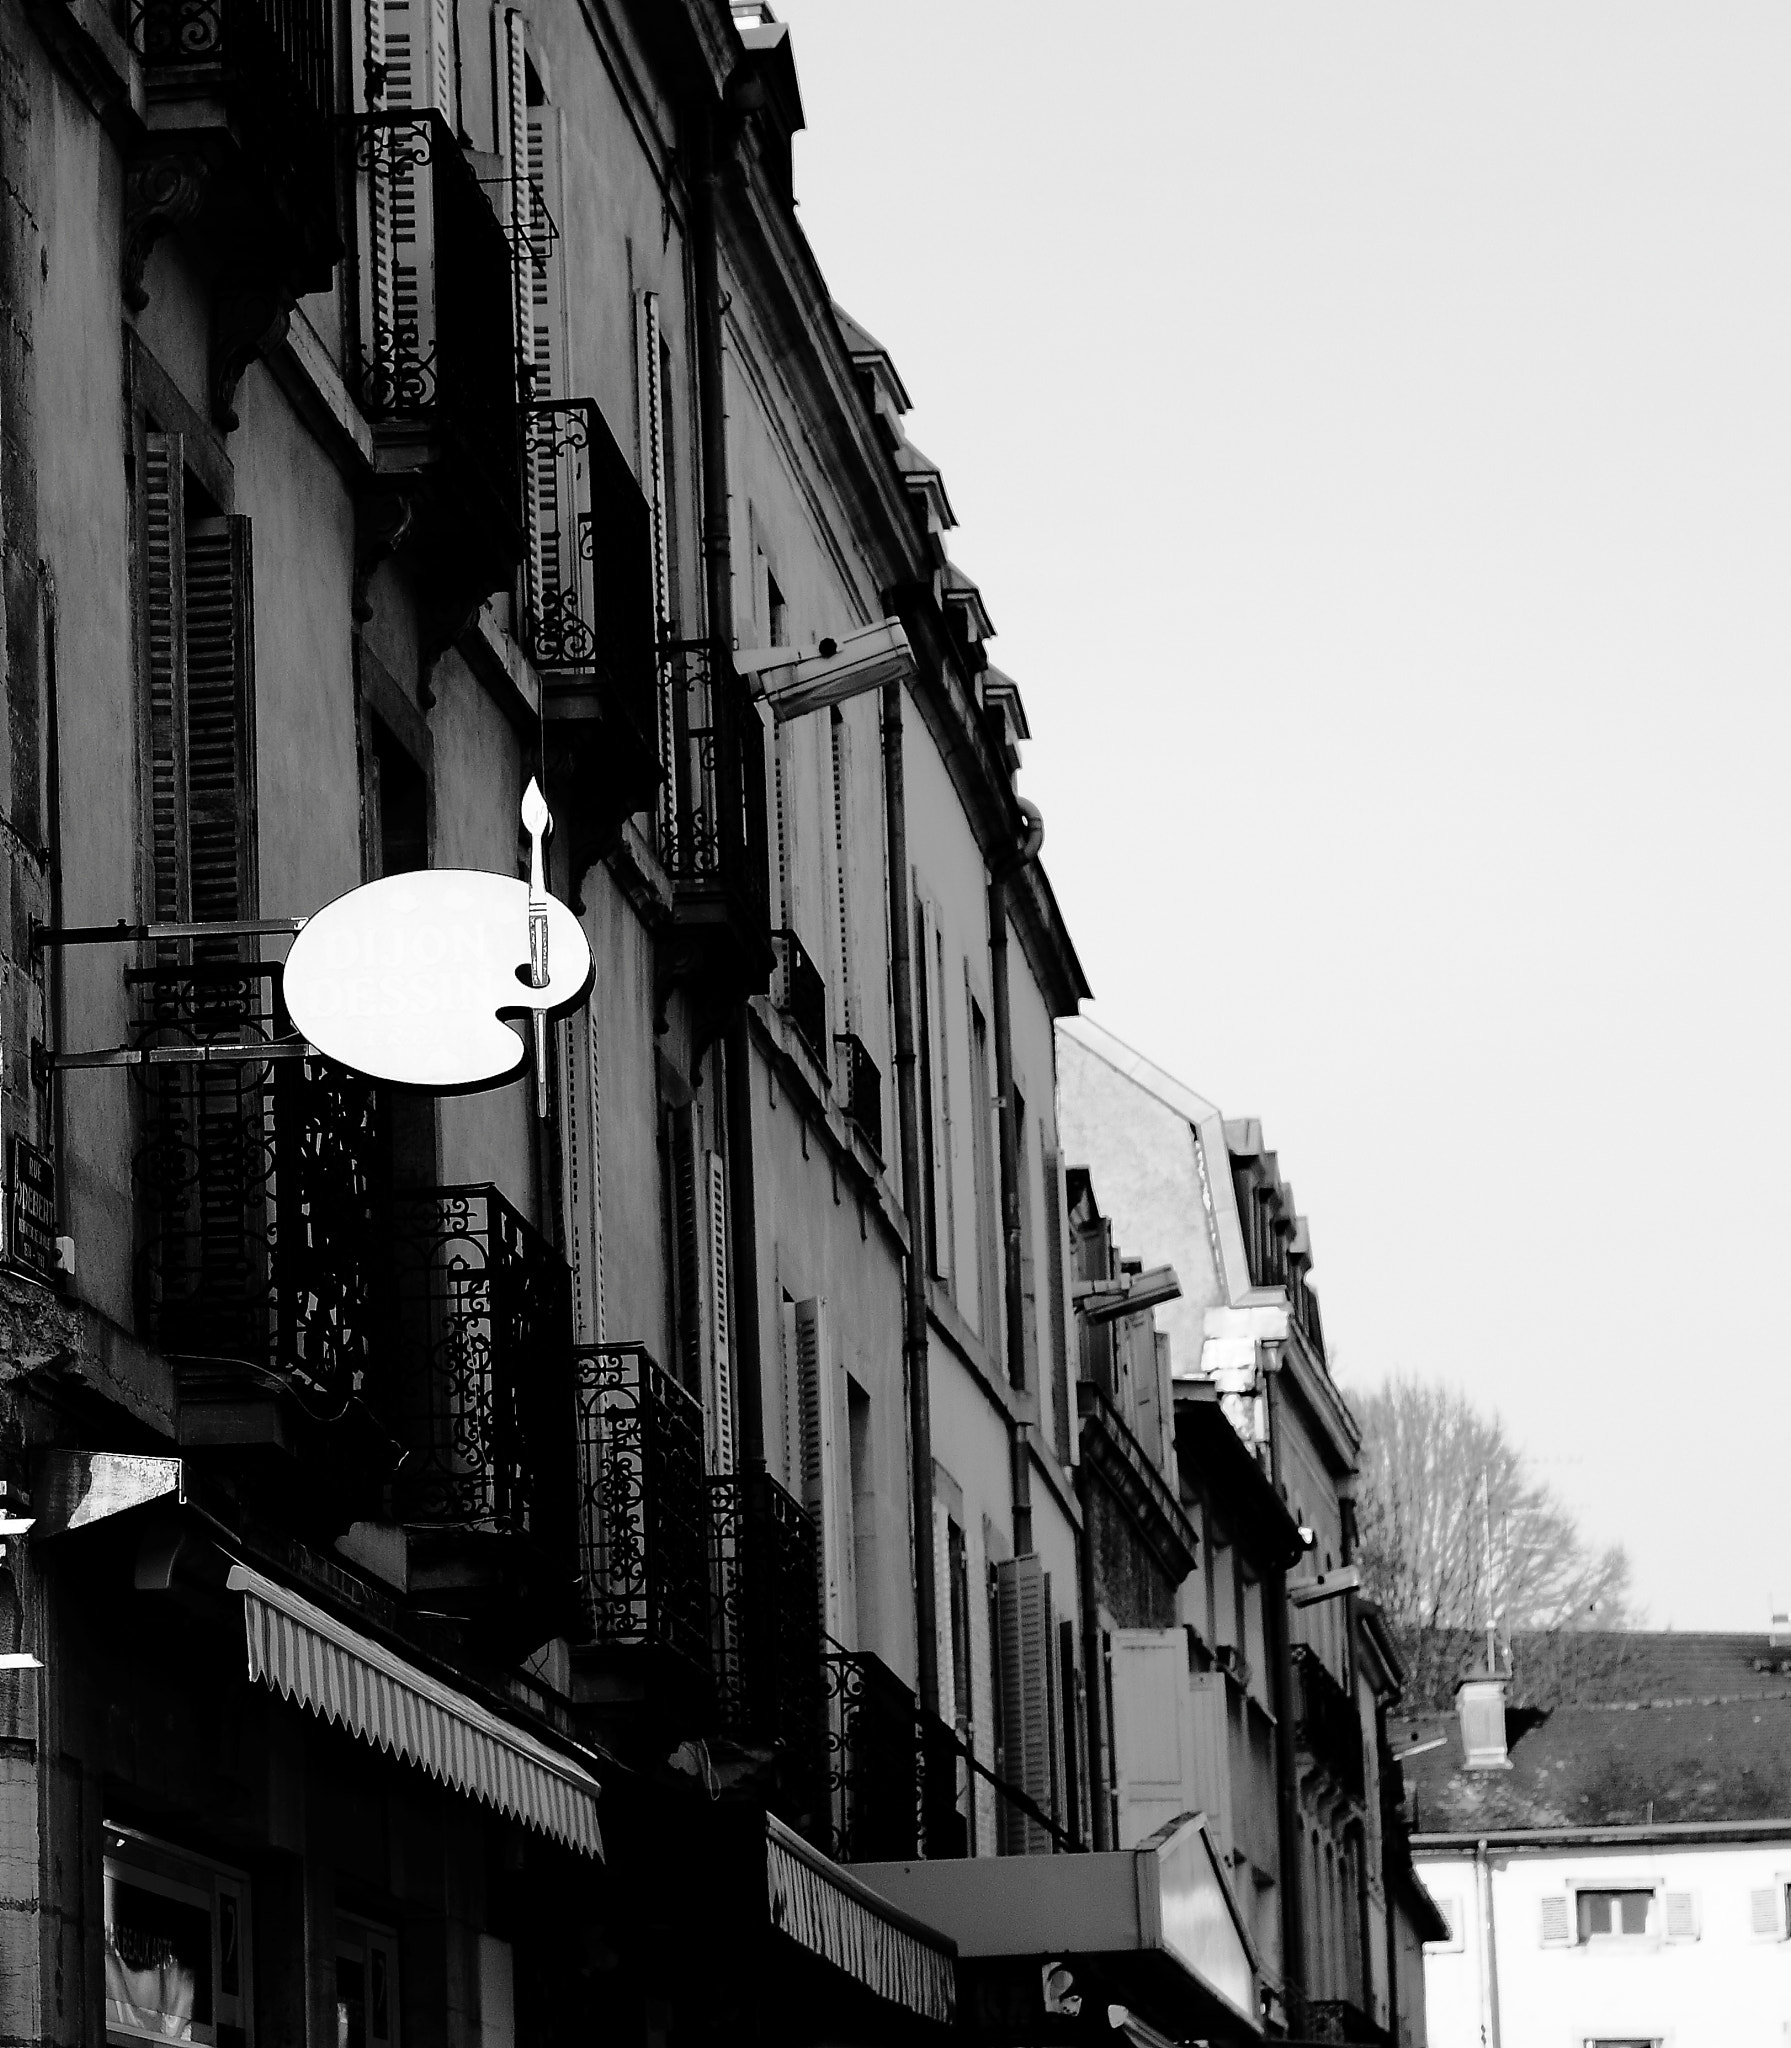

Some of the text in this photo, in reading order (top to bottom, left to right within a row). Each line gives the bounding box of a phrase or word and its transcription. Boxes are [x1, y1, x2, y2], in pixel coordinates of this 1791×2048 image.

[322, 922, 485, 970] DIJON
[306, 971, 493, 1018] DESSIN
[28, 1156, 42, 1182] RUE
[15, 1180, 54, 1229] ODEBERT
